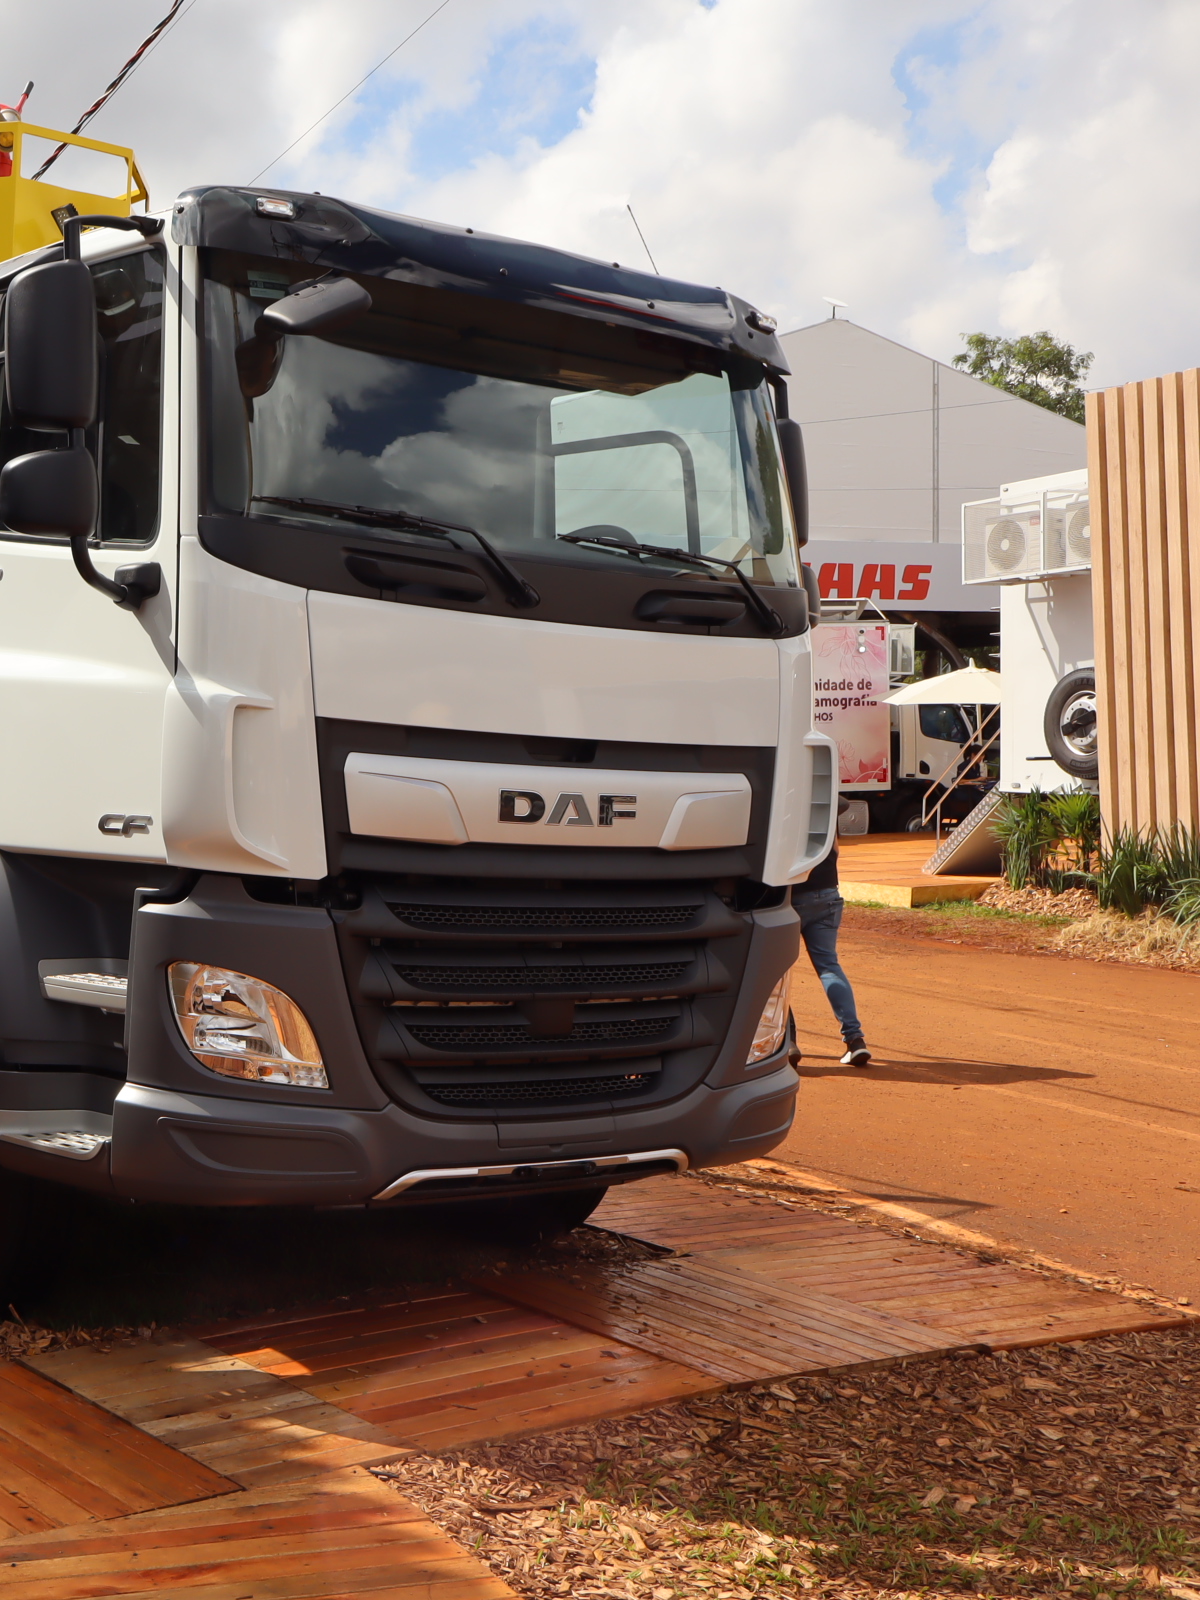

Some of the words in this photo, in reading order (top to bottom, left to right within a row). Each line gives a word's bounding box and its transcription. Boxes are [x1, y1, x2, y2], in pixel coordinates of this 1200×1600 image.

[802, 562, 932, 600] AAS
[857, 678, 872, 691] de
[498, 788, 637, 828] DAF
[98, 812, 153, 836] CF
